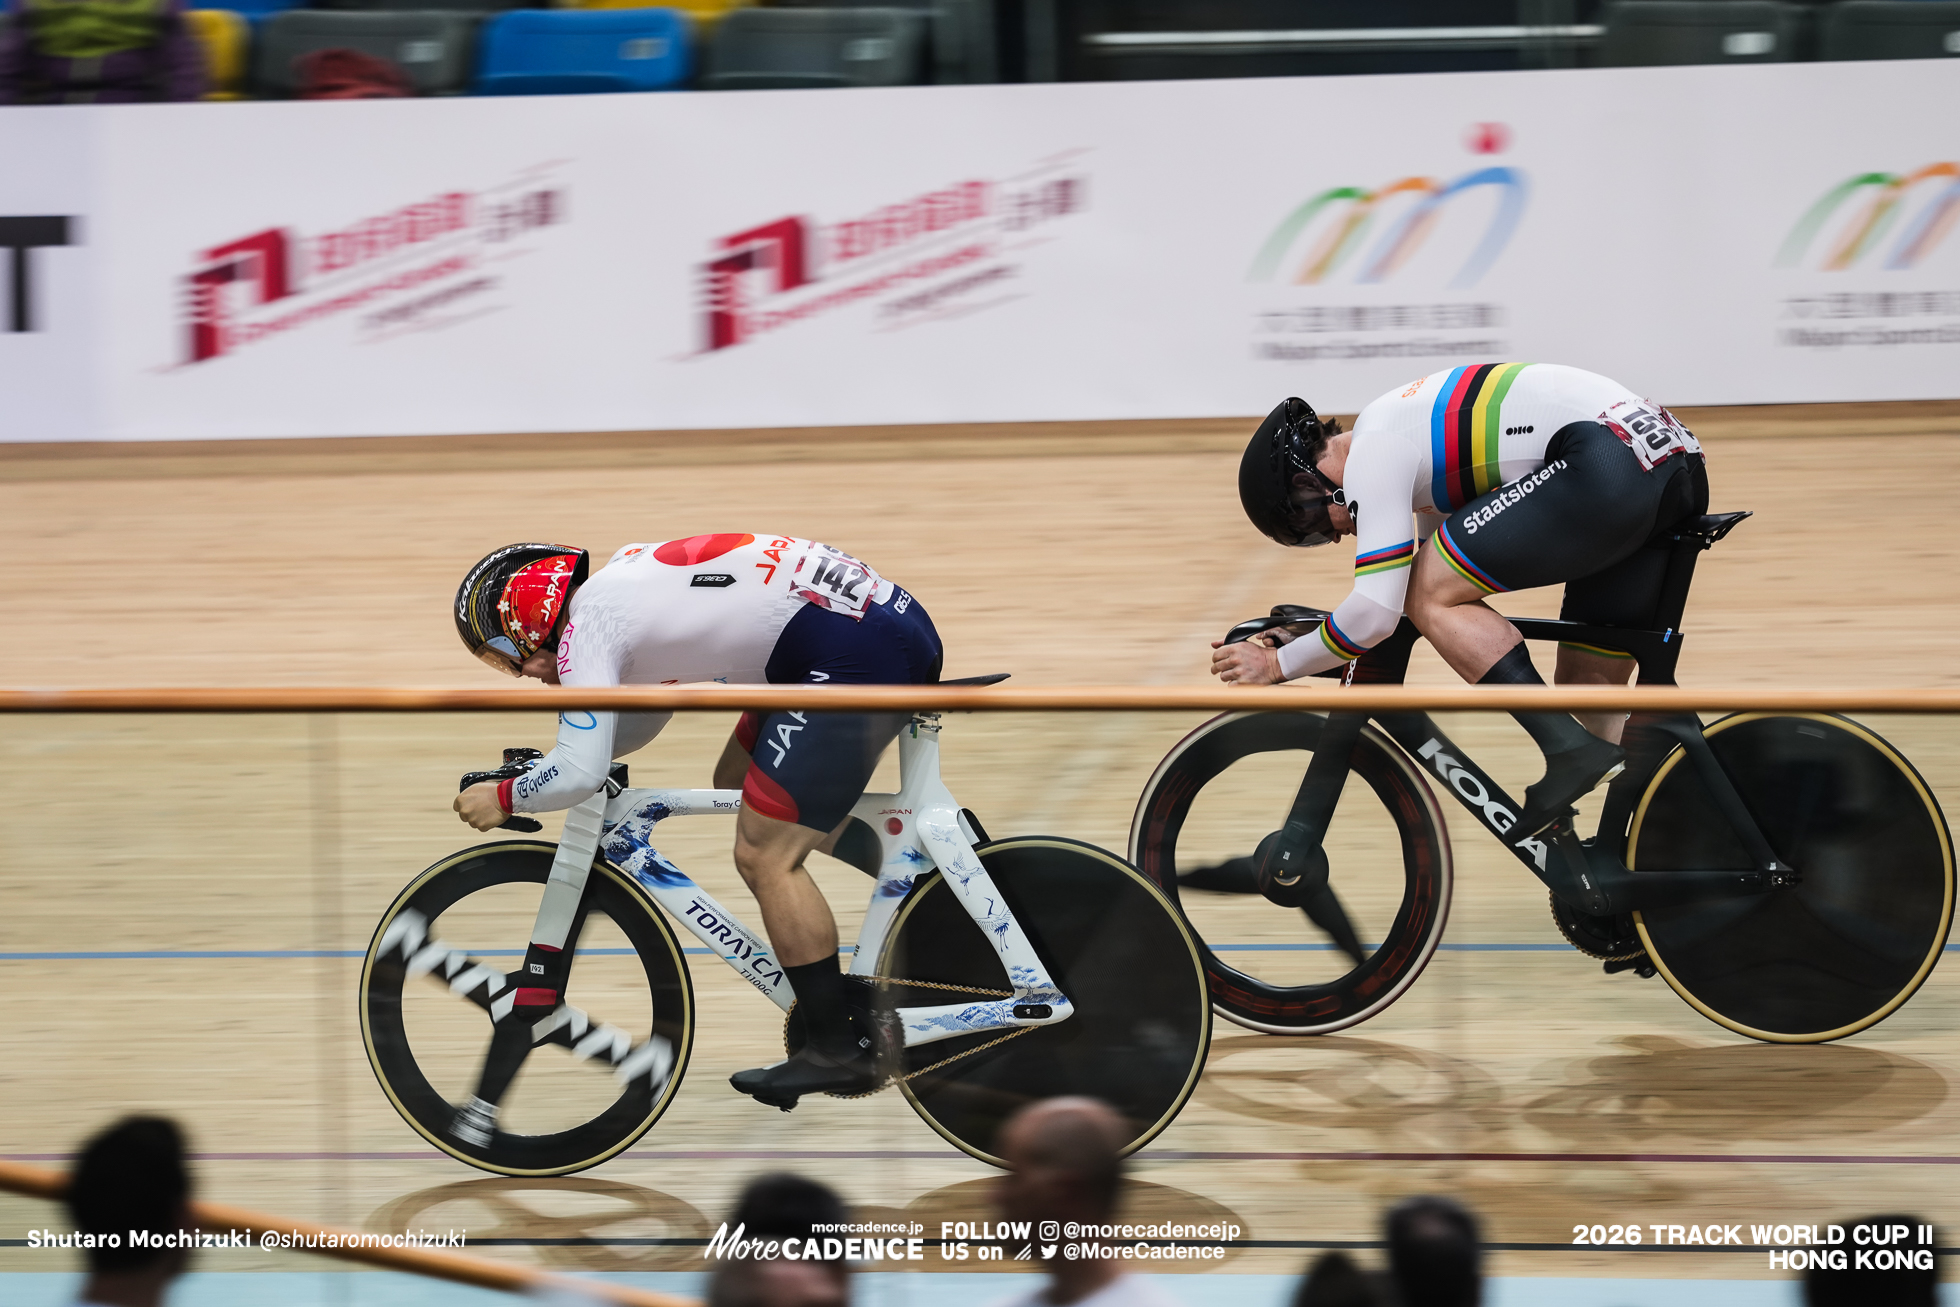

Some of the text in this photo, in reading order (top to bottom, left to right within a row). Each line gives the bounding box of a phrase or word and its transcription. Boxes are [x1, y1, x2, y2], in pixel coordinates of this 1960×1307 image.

[1621, 406, 1672, 451] 155
[1463, 459, 1567, 535] Staatsloterij
[540, 560, 567, 622] JAPAN
[811, 555, 869, 603] 142
[712, 800, 733, 809] Toray
[1417, 737, 1548, 873] KOGA
[685, 899, 784, 987] TORAYCA
[740, 967, 773, 996] T1100G
